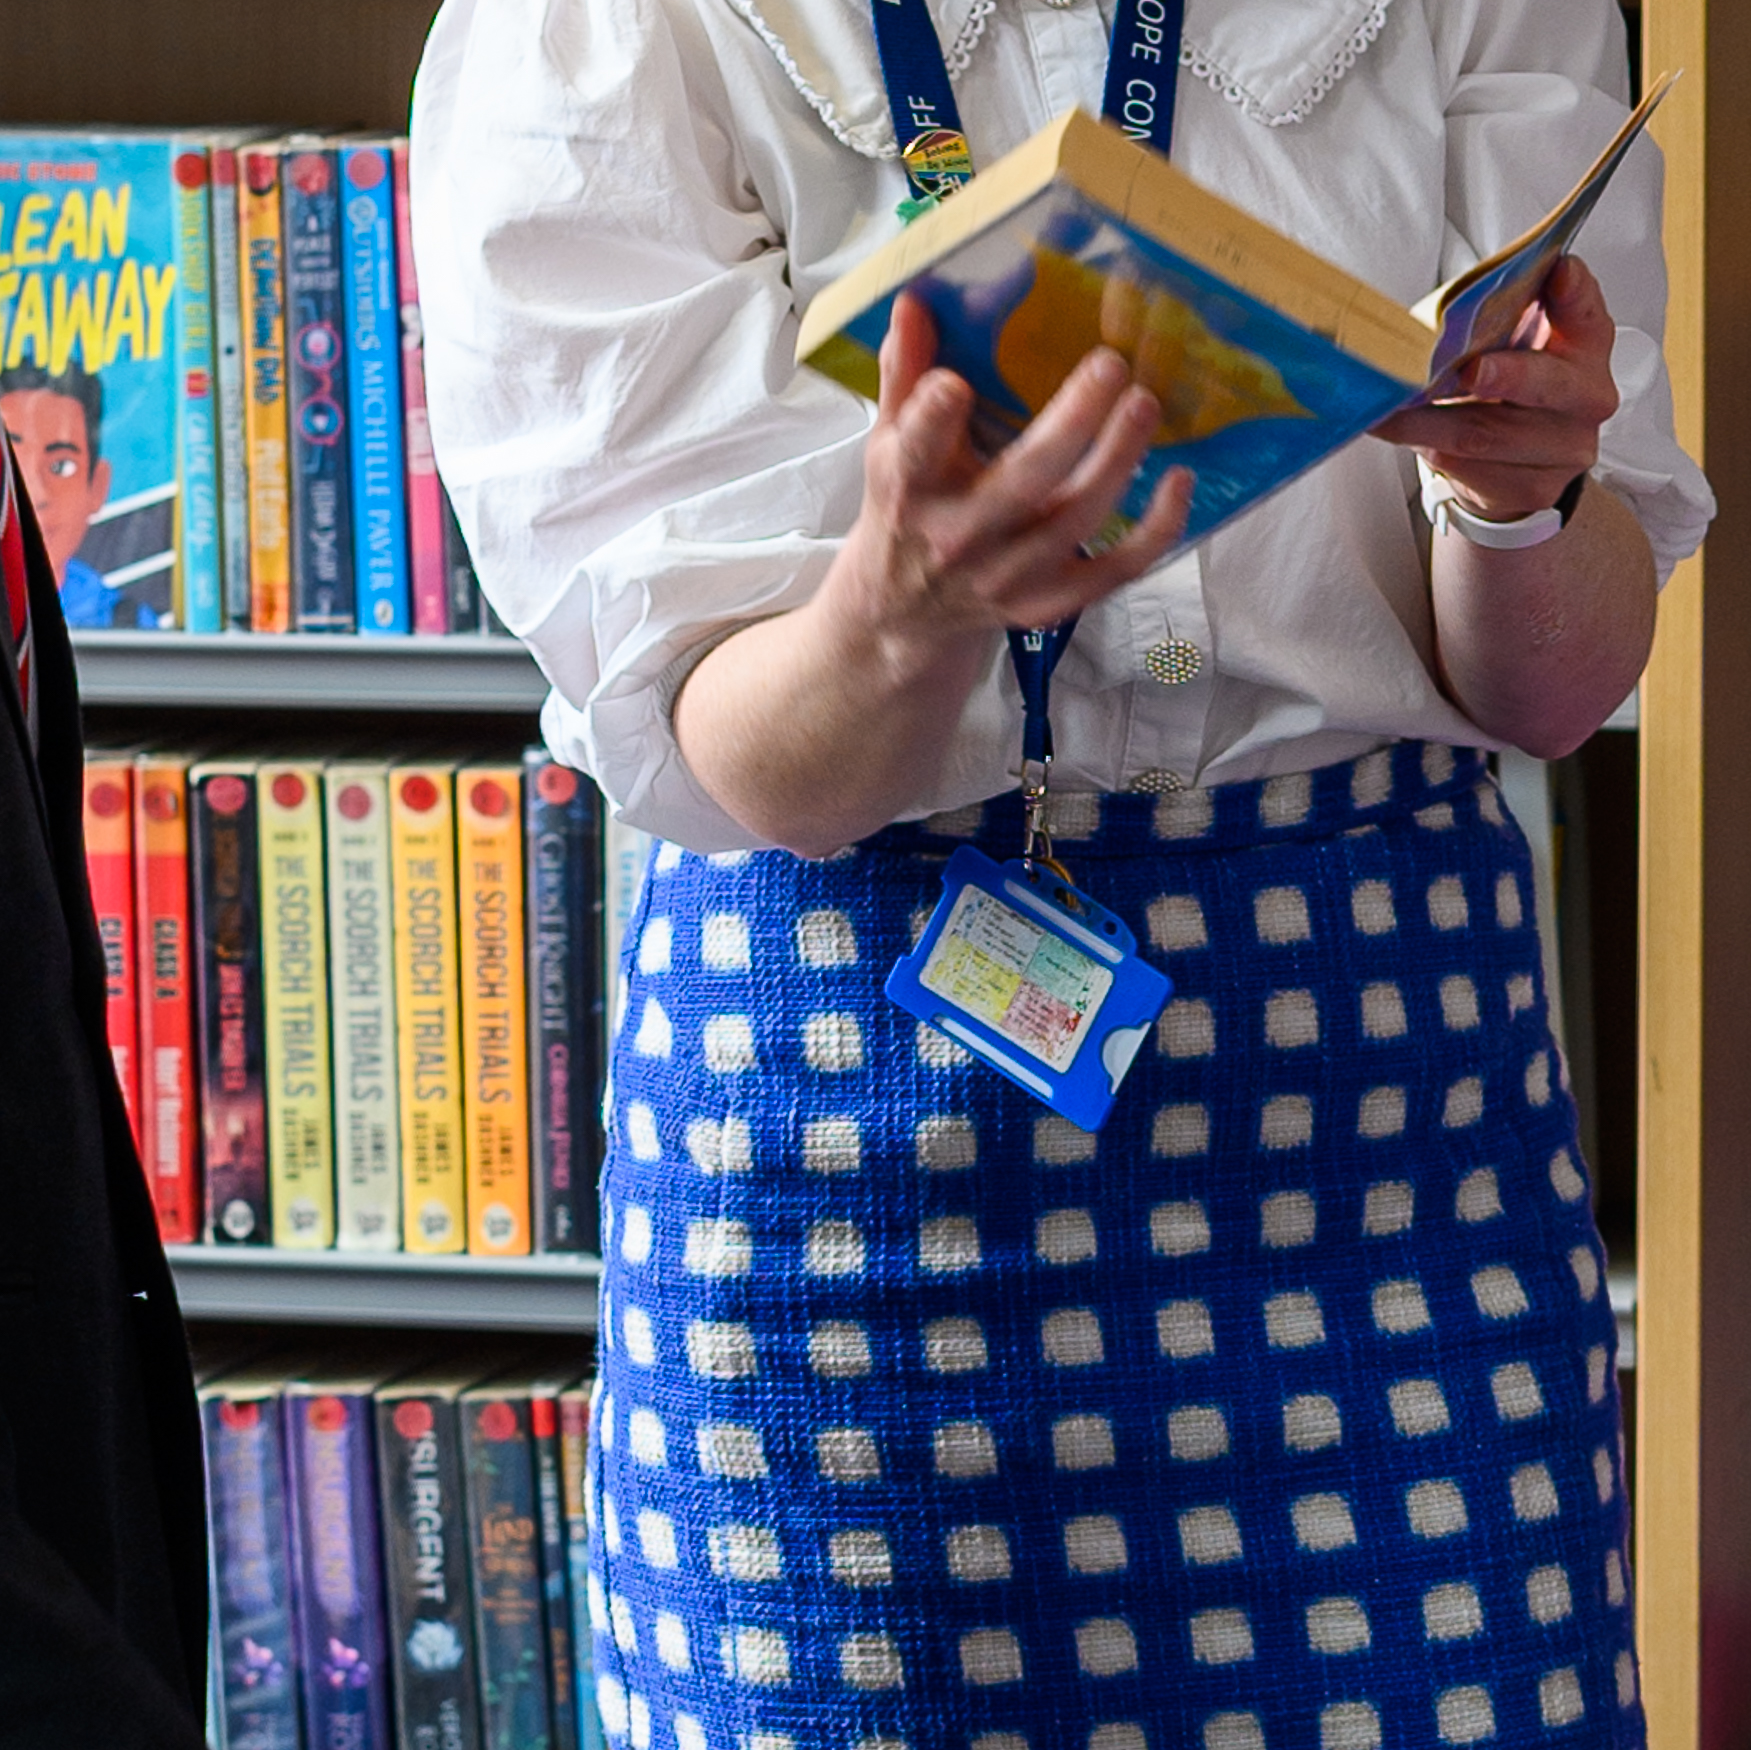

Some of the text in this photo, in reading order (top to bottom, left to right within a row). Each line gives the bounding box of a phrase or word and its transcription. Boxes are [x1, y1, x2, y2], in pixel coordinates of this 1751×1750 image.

[361, 358, 392, 496] MICHELLE
[367, 508, 394, 592] PAVER
[276, 883, 314, 995] SCORCH
[344, 887, 380, 998] SCORCH
[408, 887, 444, 998] SCORCH
[475, 889, 509, 1000] SCORCH
[280, 1005, 318, 1099] TRIALS
[348, 1006, 384, 1102] TRIALS
[411, 1006, 447, 1102] TRIALS
[477, 1010, 513, 1105] TRIALS
